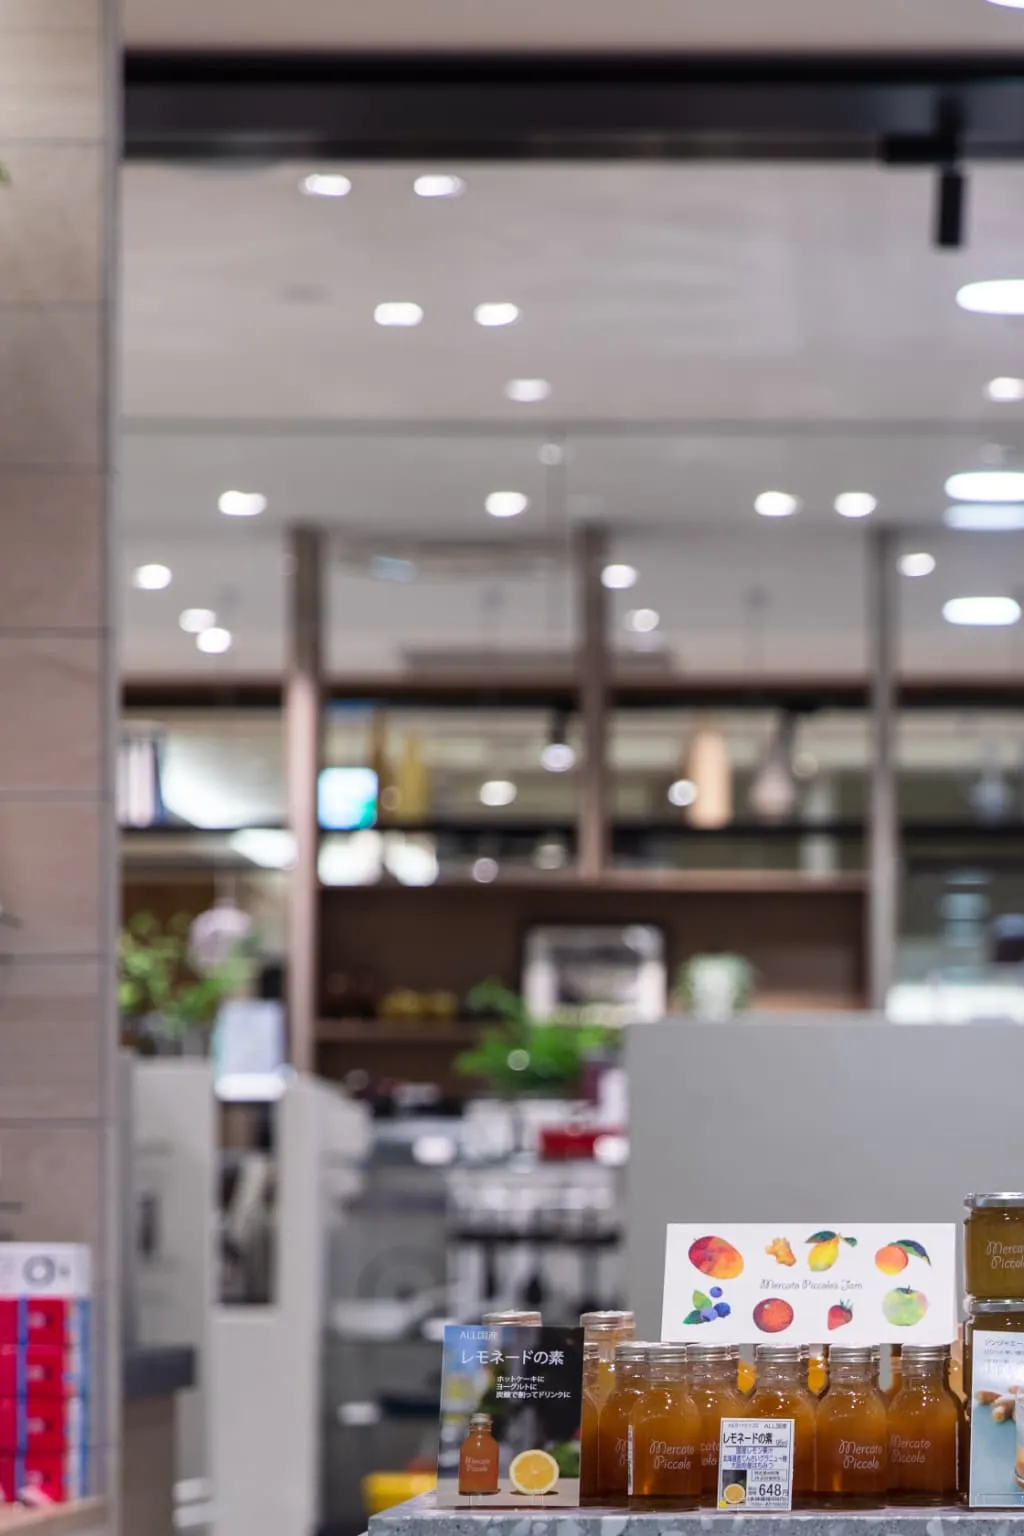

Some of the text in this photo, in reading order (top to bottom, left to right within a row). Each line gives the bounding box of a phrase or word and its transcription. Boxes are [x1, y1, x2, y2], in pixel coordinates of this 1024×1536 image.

[760, 1279, 799, 1290] Mercato
[461, 1349, 565, 1366] レモネードの素
[496, 1383, 537, 1391] ヨーグルトに
[723, 1432, 773, 1444] レモネードの素
[650, 1438, 695, 1456] Mercato
[838, 1439, 883, 1455] Mercato
[653, 1455, 692, 1470] Piccolo
[843, 1455, 880, 1470] Piccolo
